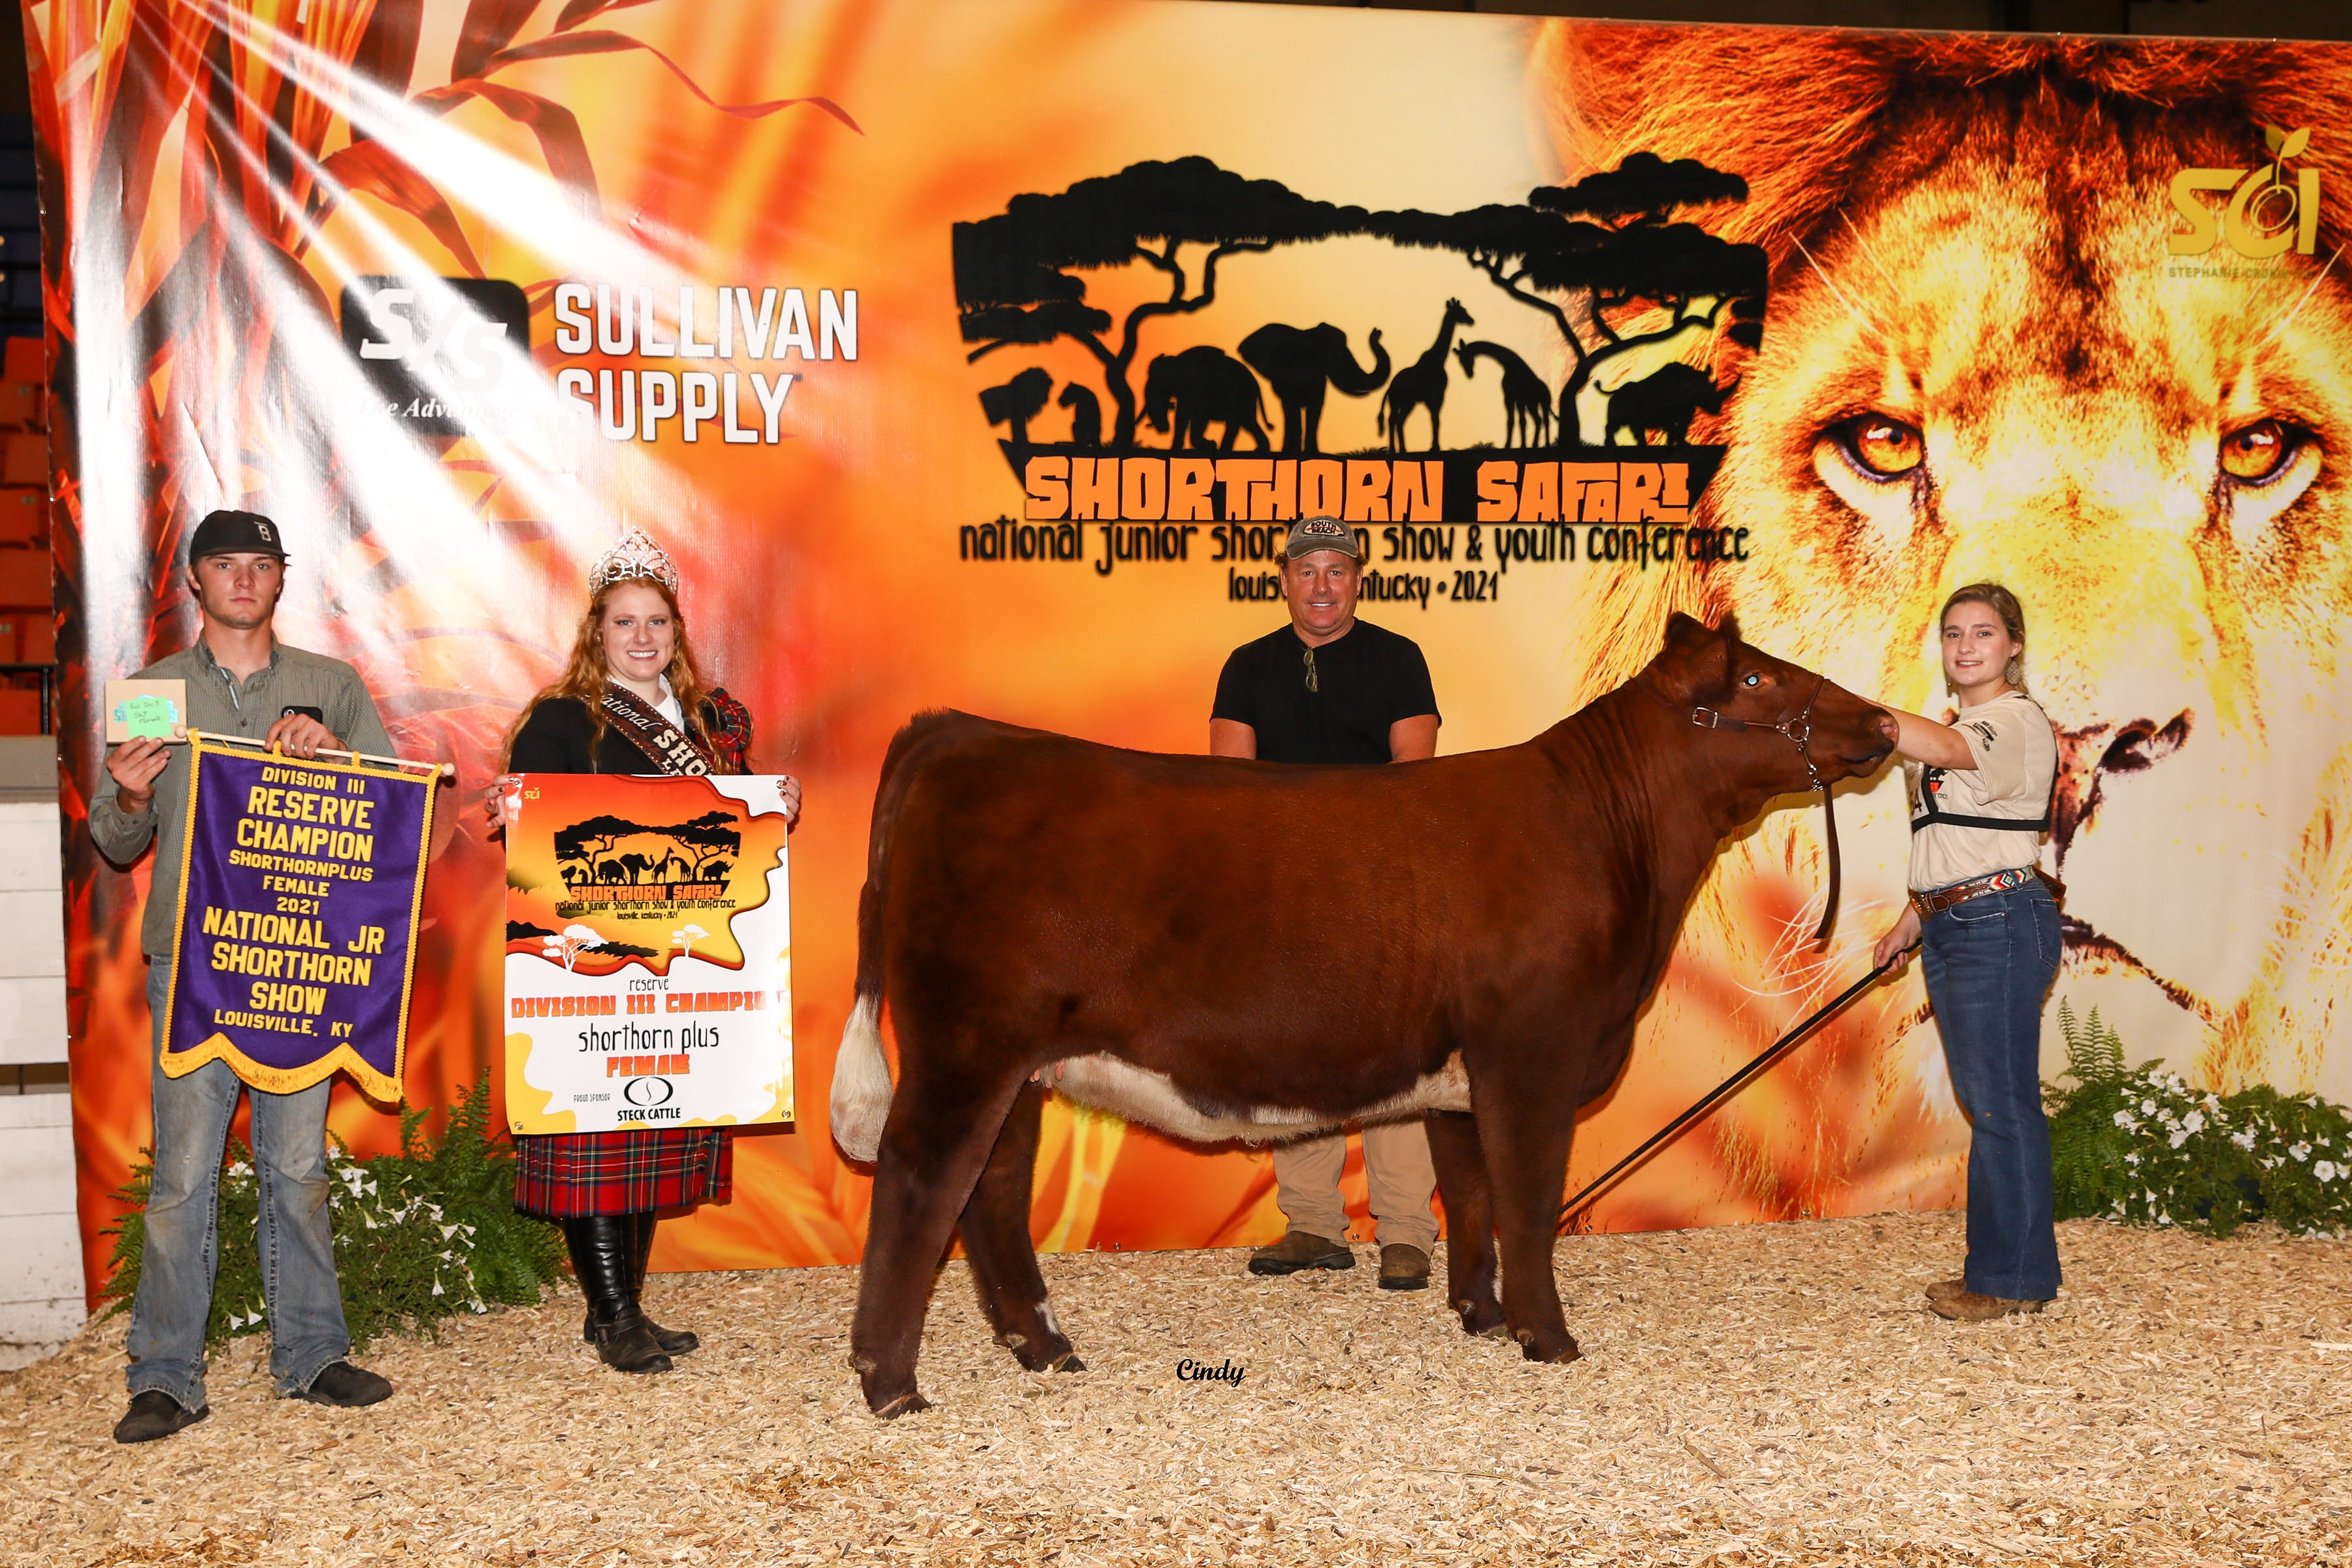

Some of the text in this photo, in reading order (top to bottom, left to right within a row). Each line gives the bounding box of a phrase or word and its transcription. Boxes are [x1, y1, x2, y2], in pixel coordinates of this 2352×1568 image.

[2169, 267, 2240, 278] STEPHANIE
[555, 283, 858, 361] SULLIVAN
[557, 368, 794, 445] SUPPLY
[1024, 455, 1690, 523] SHORTHORN SAFARI
[1311, 520, 1336, 530] SOUTH
[960, 512, 1749, 576] national junior shorn show & youth conference
[1358, 569, 1430, 609] ntucky
[1451, 570, 1498, 601] 2021
[586, 693, 662, 730] ational
[653, 729, 711, 776] SHO
[261, 766, 366, 794] DIVISION III
[247, 786, 375, 829] RESERVE
[237, 819, 374, 862] CHAMPION
[229, 851, 374, 882] SHORTHORNPLUS
[263, 876, 331, 898] FEMALE
[570, 884, 722, 902] SHORTHORN SAFARI
[276, 896, 320, 915] 2021
[555, 900, 583, 911] national
[587, 900, 610, 914] junior
[613, 900, 649, 910] shorthorn
[653, 900, 668, 909] show
[677, 899, 695, 911] youth
[697, 898, 736, 910] conference
[666, 911, 678, 919] 2021
[203, 906, 385, 955] NATIONAL JR
[211, 943, 372, 987] SHORTHORN
[250, 982, 327, 1015] SHOW
[630, 977, 669, 991] reserve
[512, 990, 785, 1018] DIVISION III CHAMPIO
[330, 1021, 353, 1037] KY
[579, 1020, 719, 1054] shorthorn plus
[607, 1053, 690, 1077] FEMALE
[574, 1093, 610, 1103] PROUD SPONSOR
[617, 1107, 681, 1121] STECK CATTLE
